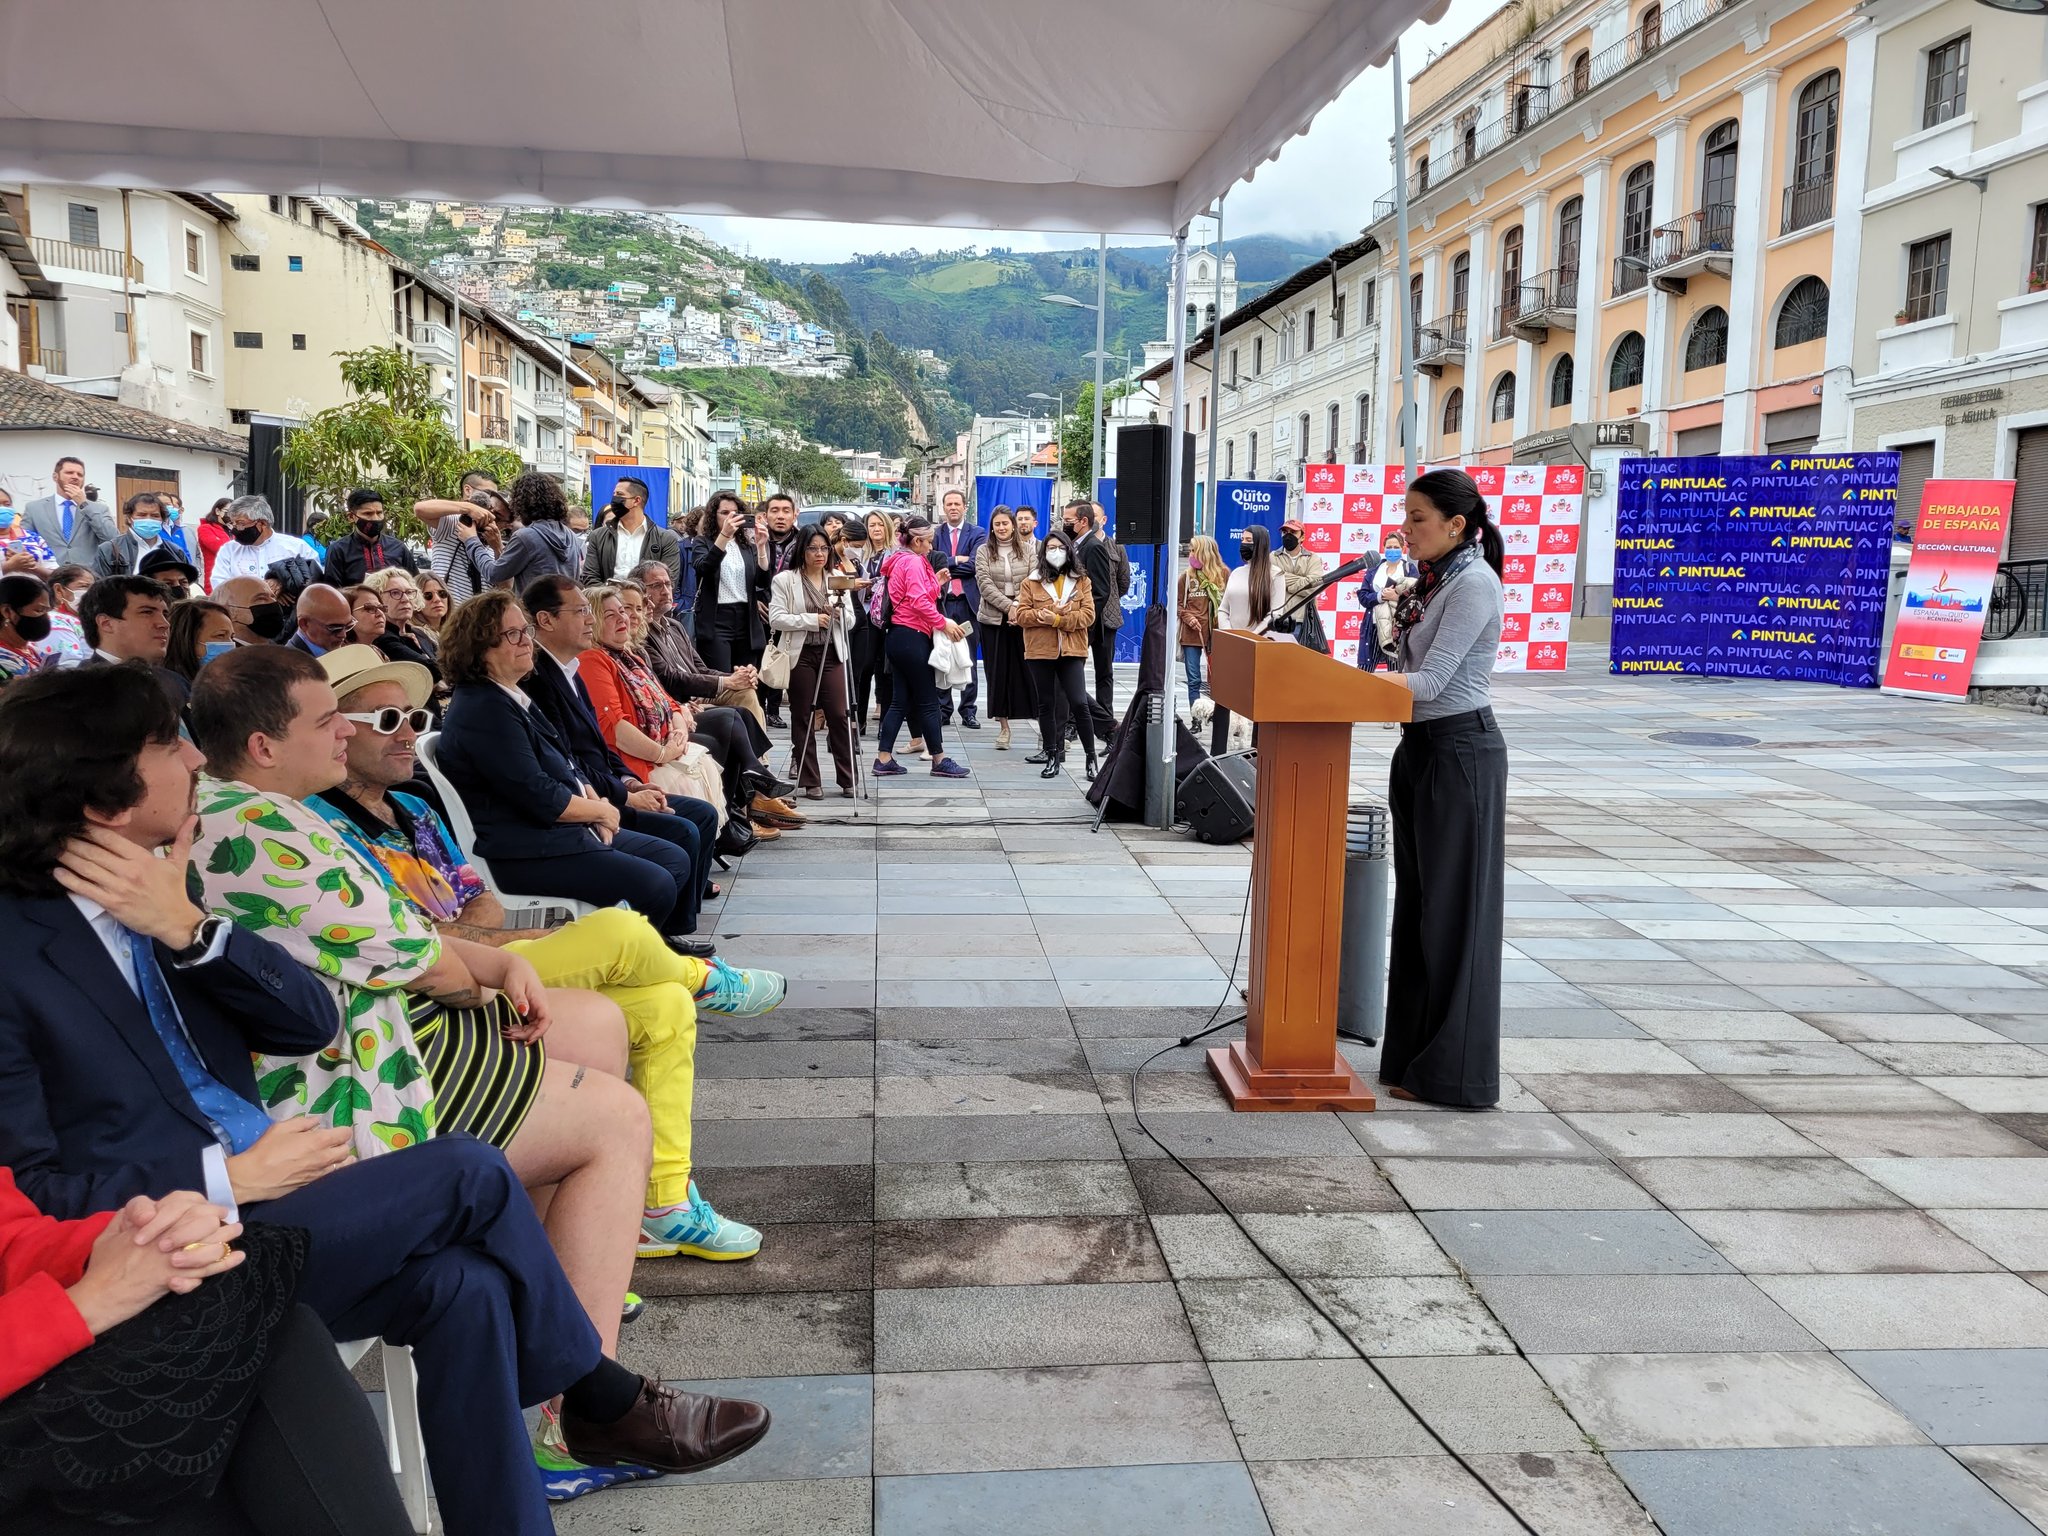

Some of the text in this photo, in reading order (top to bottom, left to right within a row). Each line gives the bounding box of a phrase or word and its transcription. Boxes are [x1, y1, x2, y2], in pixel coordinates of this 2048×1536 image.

[1790, 457, 1855, 470] PINTULAC
[1660, 477, 1727, 489] PINTULAC
[1752, 475, 1819, 487] PINTULAC
[1841, 473, 1898, 484] PINTULA
[1231, 489, 1271, 505] Quito
[1680, 492, 1747, 503] PINTULAC
[1243, 502, 1270, 513] Digno
[1749, 506, 1816, 518] PINTULAC
[1838, 505, 1896, 516] PINTULA
[1928, 504, 2001, 518] EMBAJADA
[1638, 523, 1702, 534] PINTULAC
[1815, 521, 1878, 532] PINTULAC
[1923, 518, 2000, 531] DE ESPAÑA
[1790, 536, 1853, 548] PINTULAC
[1916, 543, 1997, 553] SECCIÓN CULTURAL
[1740, 552, 1807, 564] PINTULAC
[1678, 566, 1746, 578] PINTULAC
[1735, 582, 1801, 594] PINTULAC
[1824, 584, 1887, 597] PINTULAC
[1777, 597, 1841, 610] PINTULAC
[1614, 613, 1851, 630] PINTULAC PINTULAC PINTULAC
[1751, 630, 1817, 644] PINTULAC
[1639, 645, 1878, 666] PINTULAC PINTULAC PINTULAC
[1621, 660, 1684, 672] PINTULAC
[1705, 662, 1772, 675] PINTULAC
